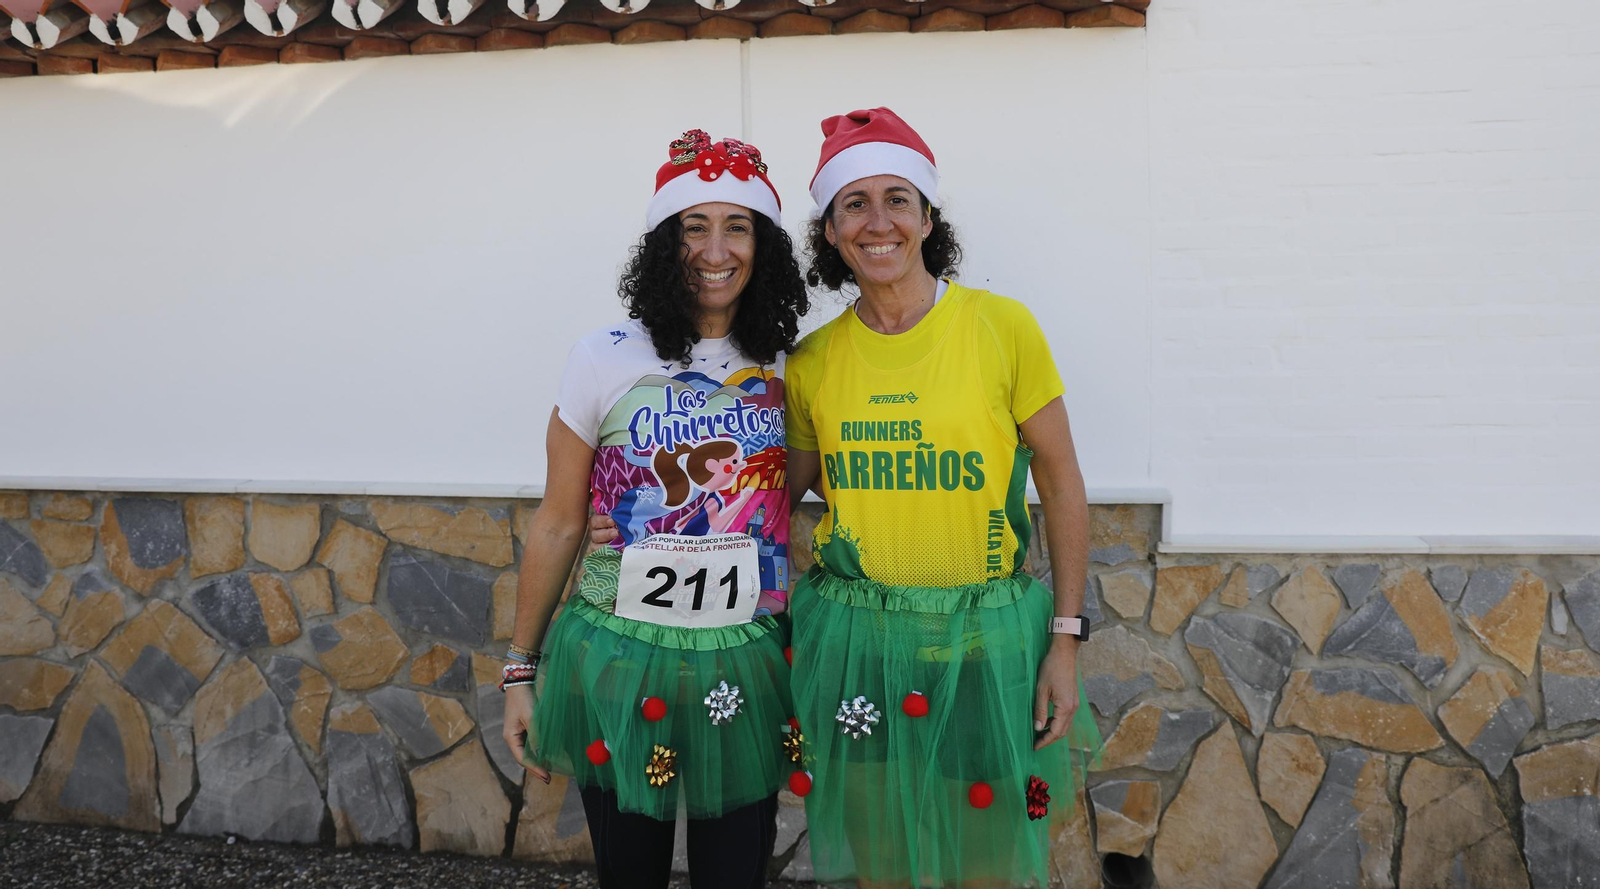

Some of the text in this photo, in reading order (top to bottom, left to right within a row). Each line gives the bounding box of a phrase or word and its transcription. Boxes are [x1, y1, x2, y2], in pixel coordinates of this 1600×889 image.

[663, 385, 707, 417] L@s
[868, 394, 906, 404] PENTEX
[841, 420, 922, 441] RUNNERS
[824, 442, 985, 491] BARREÑOS
[987, 509, 1005, 550] VILLA
[659, 536, 694, 545] POPULAR
[695, 537, 719, 545] LÚDICO
[713, 541, 751, 551] FRONTERA
[987, 554, 1002, 573] DE
[641, 565, 738, 611] 211
